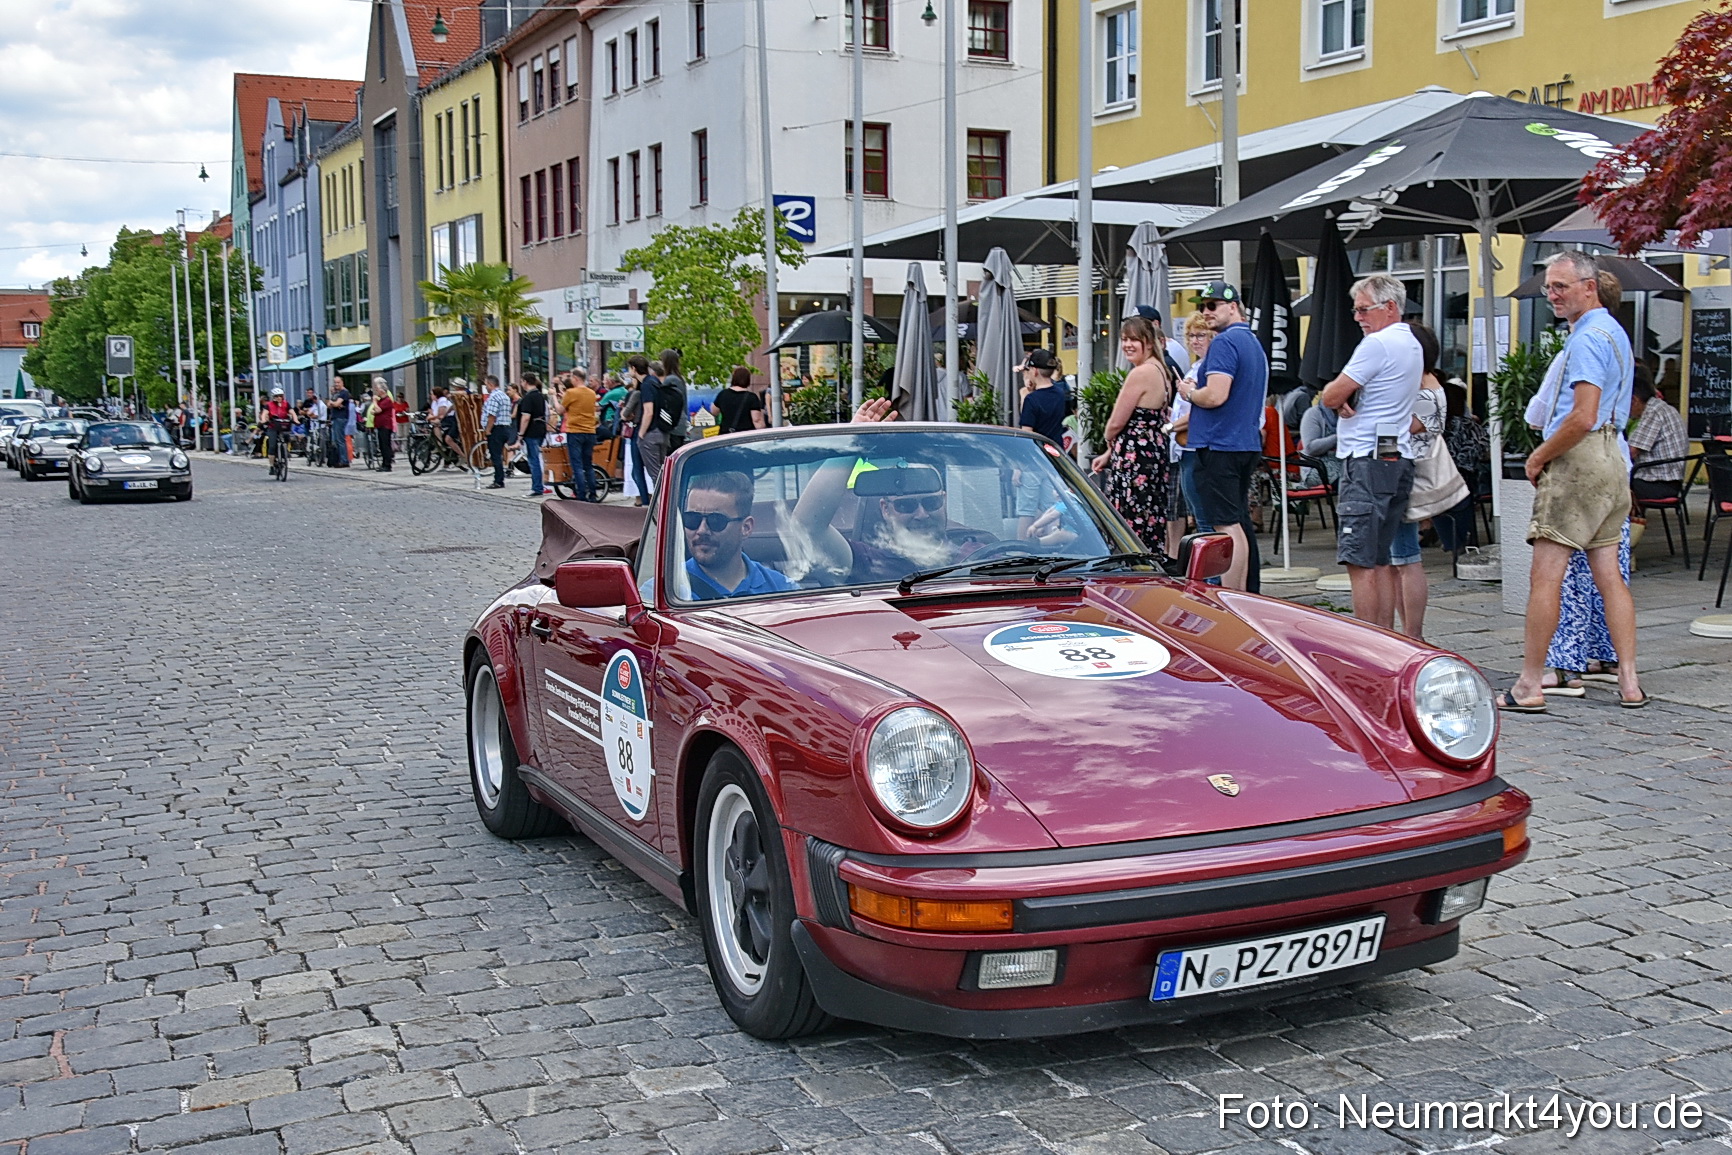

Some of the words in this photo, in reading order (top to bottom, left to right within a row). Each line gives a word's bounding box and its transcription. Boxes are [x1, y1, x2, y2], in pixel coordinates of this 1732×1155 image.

[1578, 89, 1608, 114] AM
[1058, 647, 1116, 662] 88
[617, 736, 634, 775] 88
[1180, 953, 1209, 992] N
[1234, 922, 1381, 983] PZ789H
